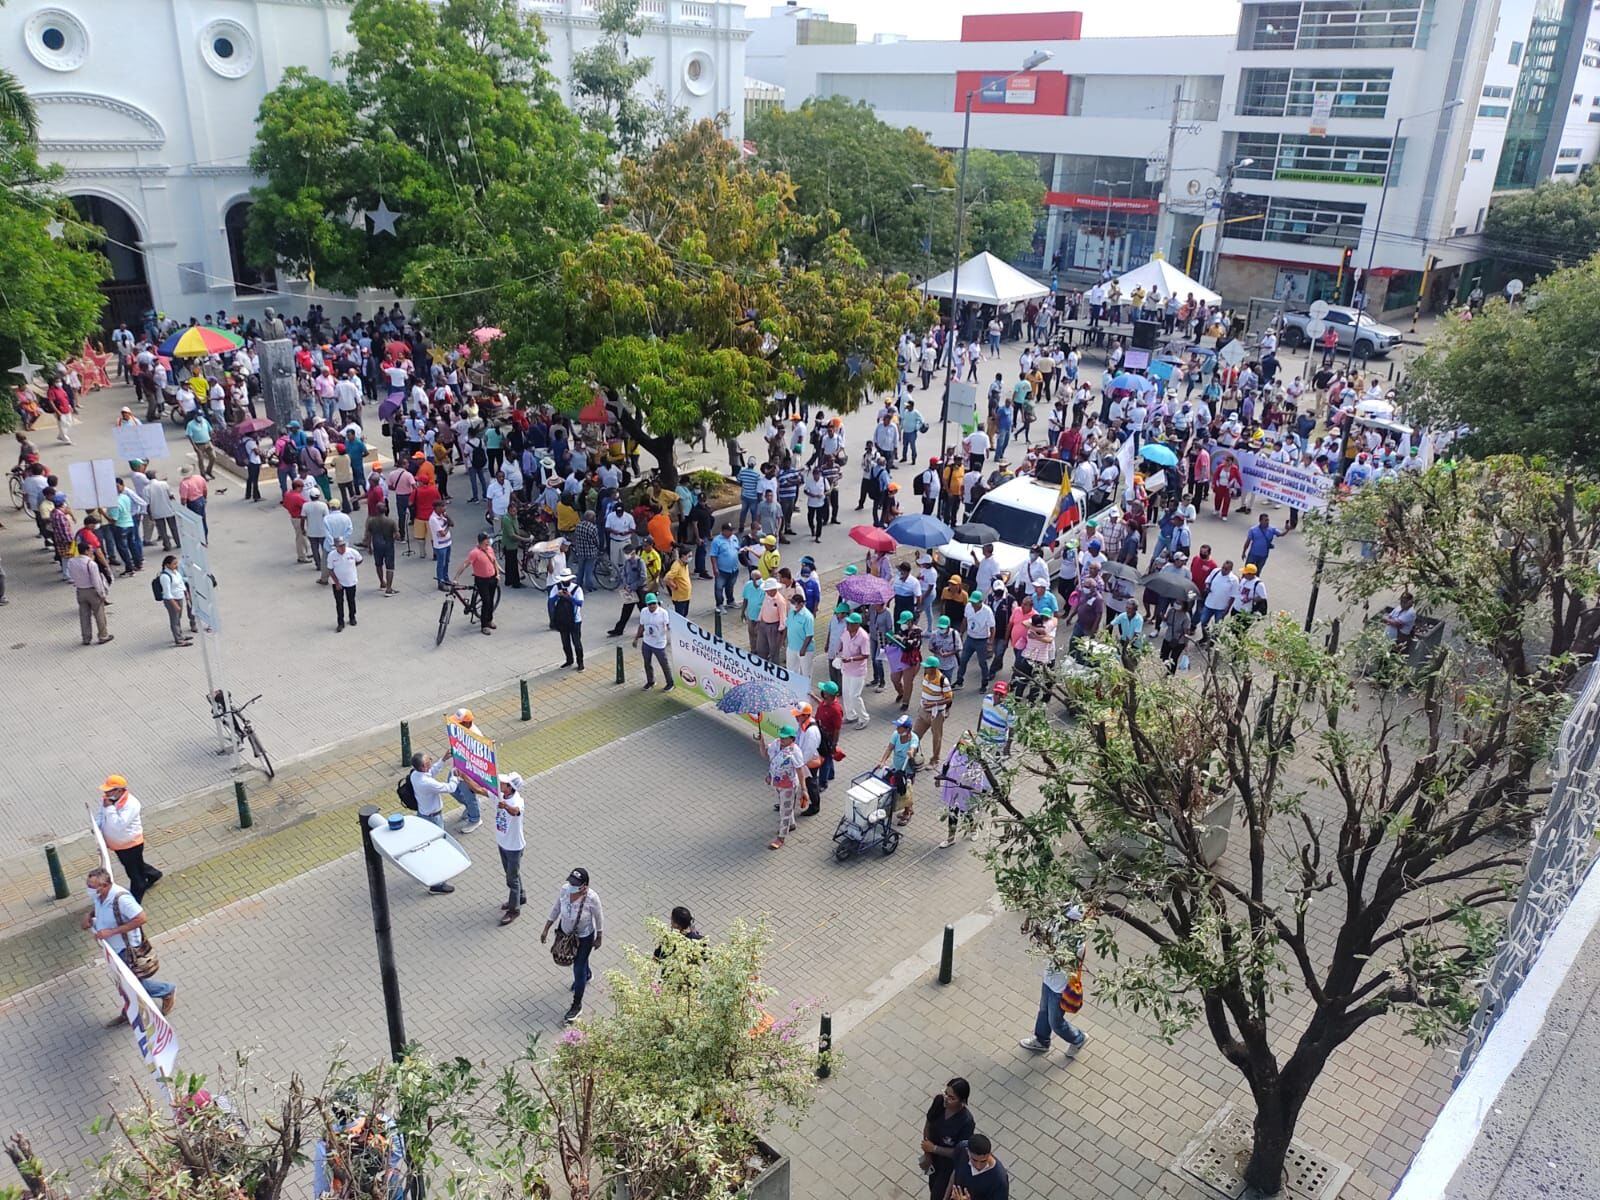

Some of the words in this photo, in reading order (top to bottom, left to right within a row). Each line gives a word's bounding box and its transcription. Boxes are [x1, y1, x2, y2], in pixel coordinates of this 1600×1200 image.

[1252, 486, 1309, 510] PRESENTE
[679, 639, 690, 650] DE
[691, 646, 748, 681] PENSIONADOS
[686, 621, 790, 682] CUPECORD
[723, 655, 740, 667] POR
[741, 663, 753, 676] LA
[449, 723, 493, 763] COLOMBIA
